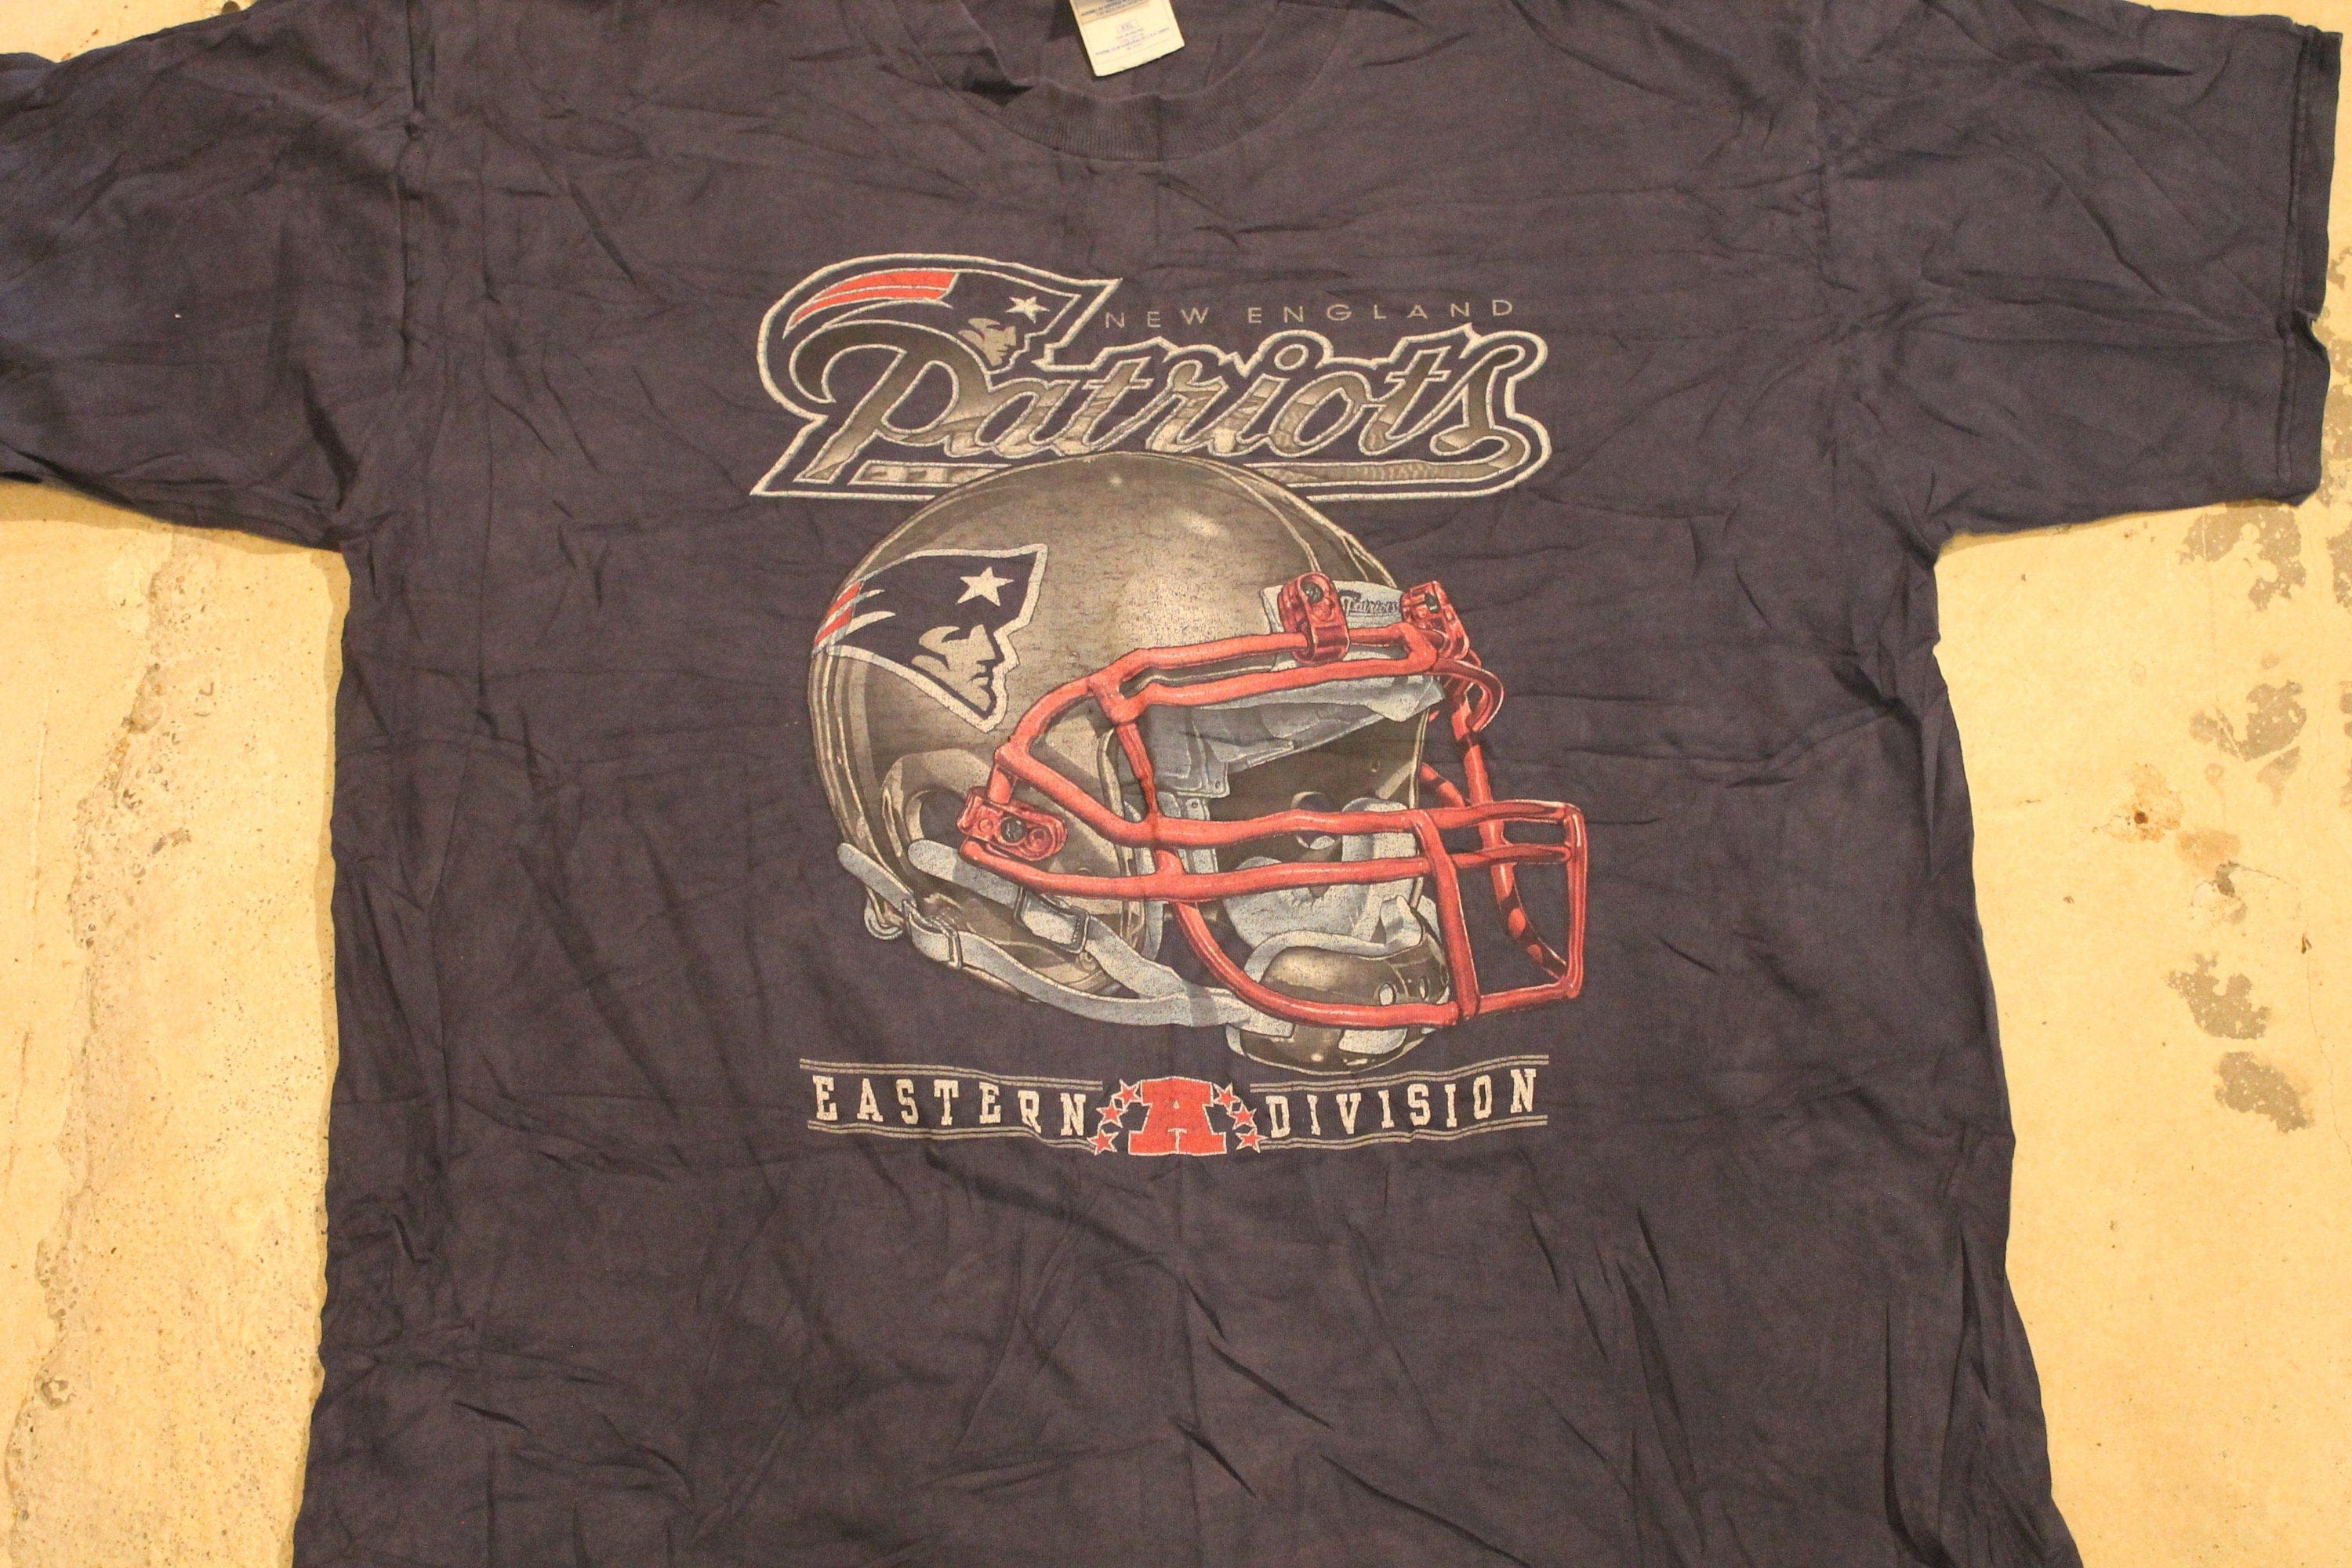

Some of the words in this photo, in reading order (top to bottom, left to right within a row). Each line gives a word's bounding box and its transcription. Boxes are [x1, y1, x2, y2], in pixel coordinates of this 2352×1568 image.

[1105, 307, 1209, 328] NEW
[1247, 299, 1513, 324] ENGLAND
[784, 270, 1530, 485] Patriots
[812, 1075, 1088, 1137] EASTERN
[1127, 1077, 1228, 1156] A
[1265, 1067, 1537, 1137] DIVISION
